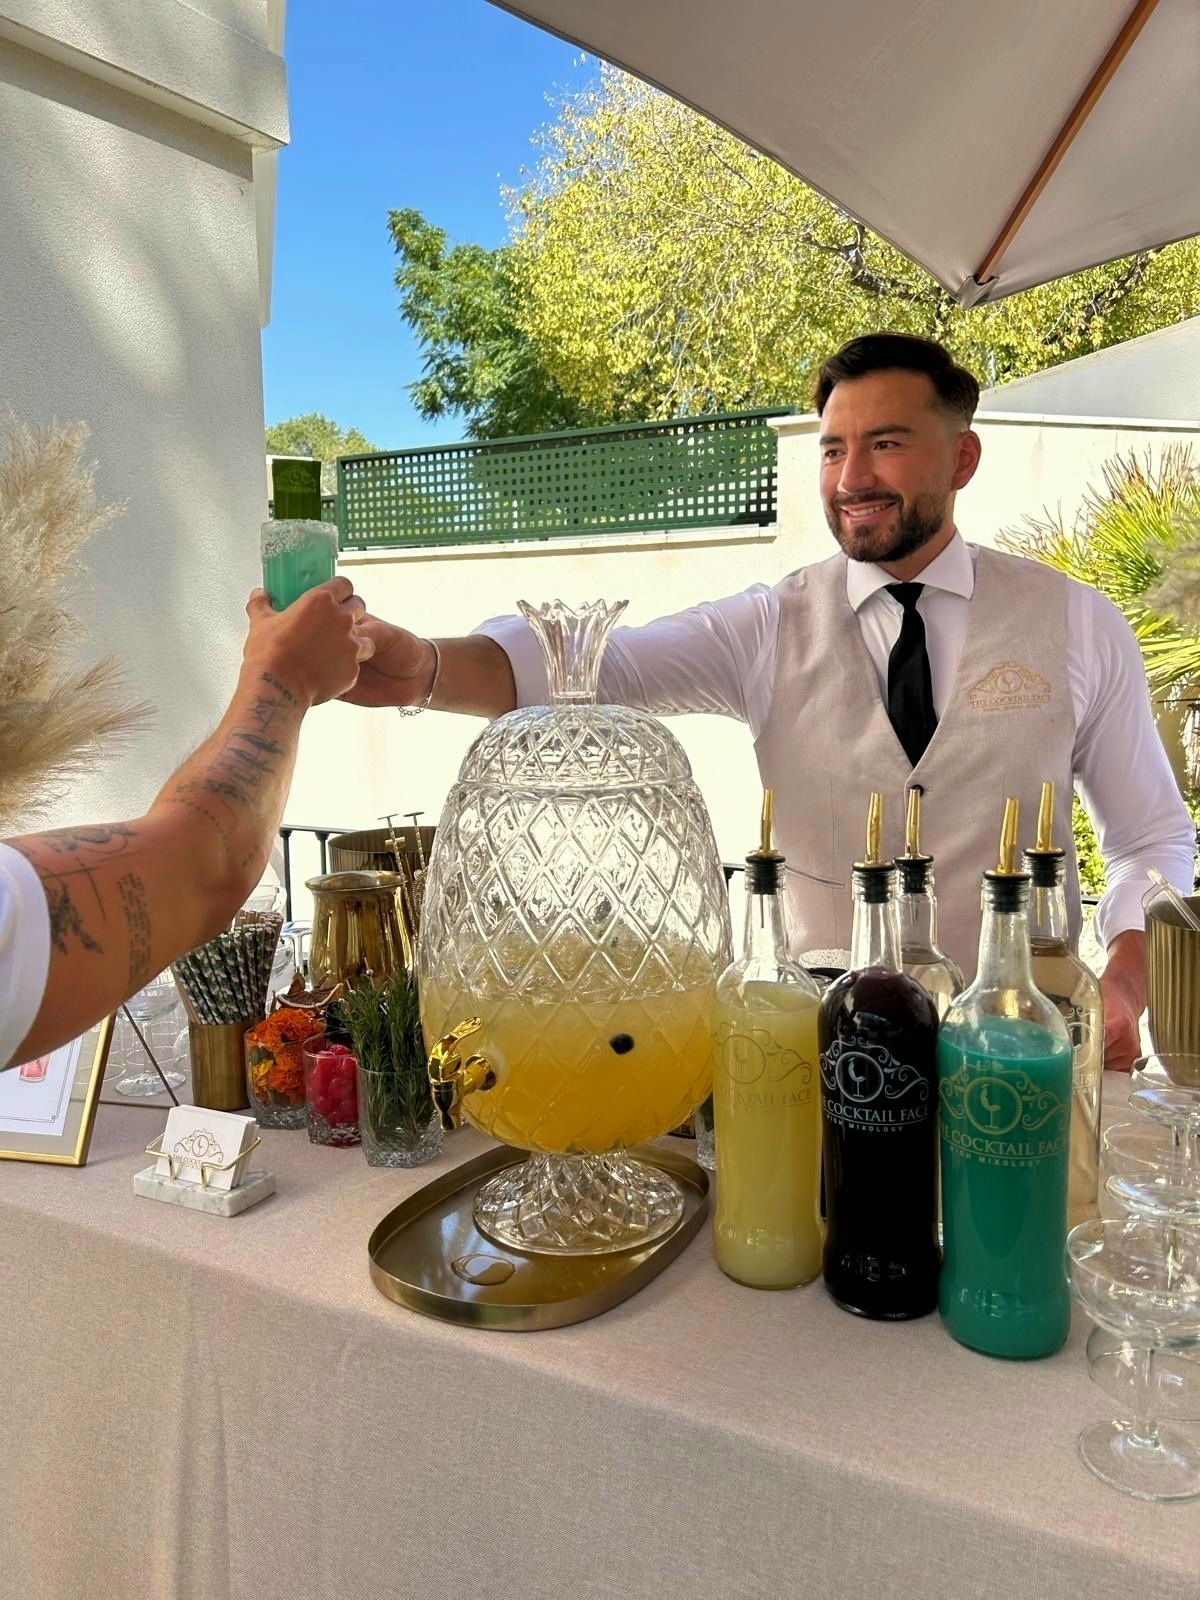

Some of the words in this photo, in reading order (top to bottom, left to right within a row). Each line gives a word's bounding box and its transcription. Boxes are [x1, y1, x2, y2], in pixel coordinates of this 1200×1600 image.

[782, 1088, 812, 1105] FACE
[827, 1099, 897, 1123] COCKTAIL
[848, 1122, 904, 1133] MIXOLOGY
[951, 1130, 1034, 1156] COCKTAIL
